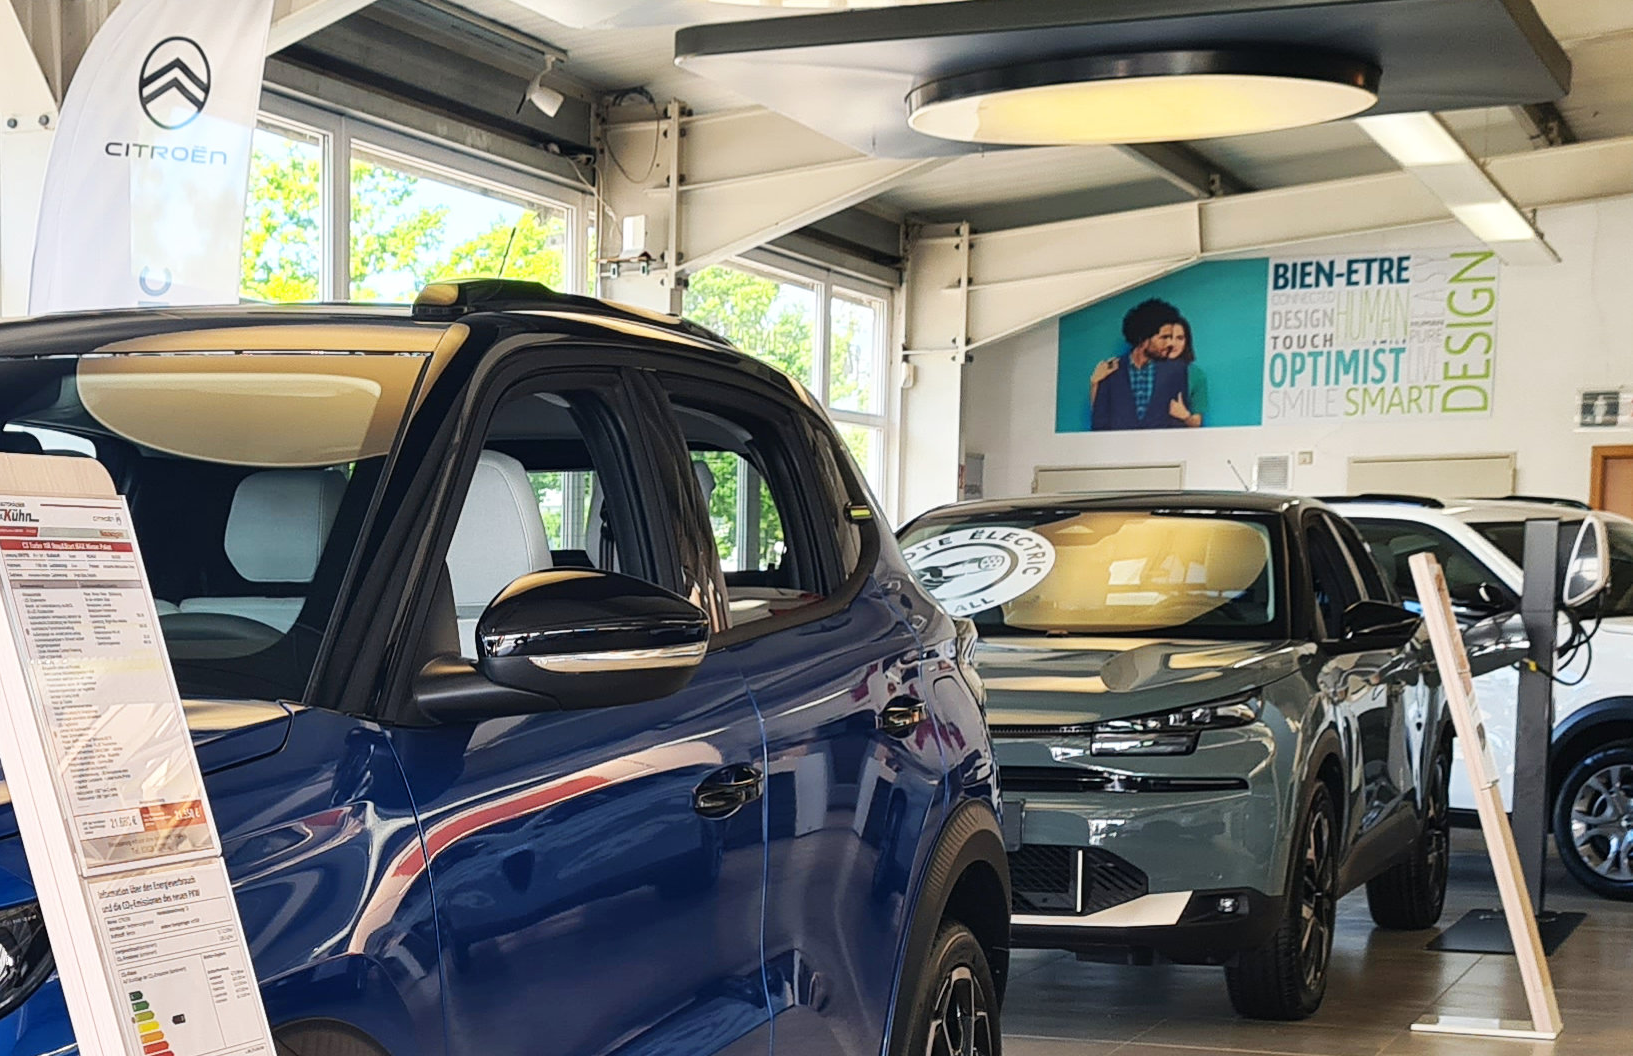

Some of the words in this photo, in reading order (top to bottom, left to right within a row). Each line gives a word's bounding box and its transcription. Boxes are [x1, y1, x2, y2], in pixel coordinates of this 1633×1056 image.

[105, 141, 227, 166] CITROËN
[1272, 254, 1411, 291] BIEN-ETRE
[1270, 308, 1335, 331] DESIGN
[1336, 287, 1411, 344] HUMAN
[1271, 333, 1334, 350] TOUCH
[1441, 250, 1497, 414] DESIGN
[1268, 347, 1407, 389] OPTIMIST
[1266, 388, 1339, 420] SMILE
[1344, 384, 1441, 417] SMART
[3, 508, 40, 522] Kühn
[953, 597, 996, 615] ALL
